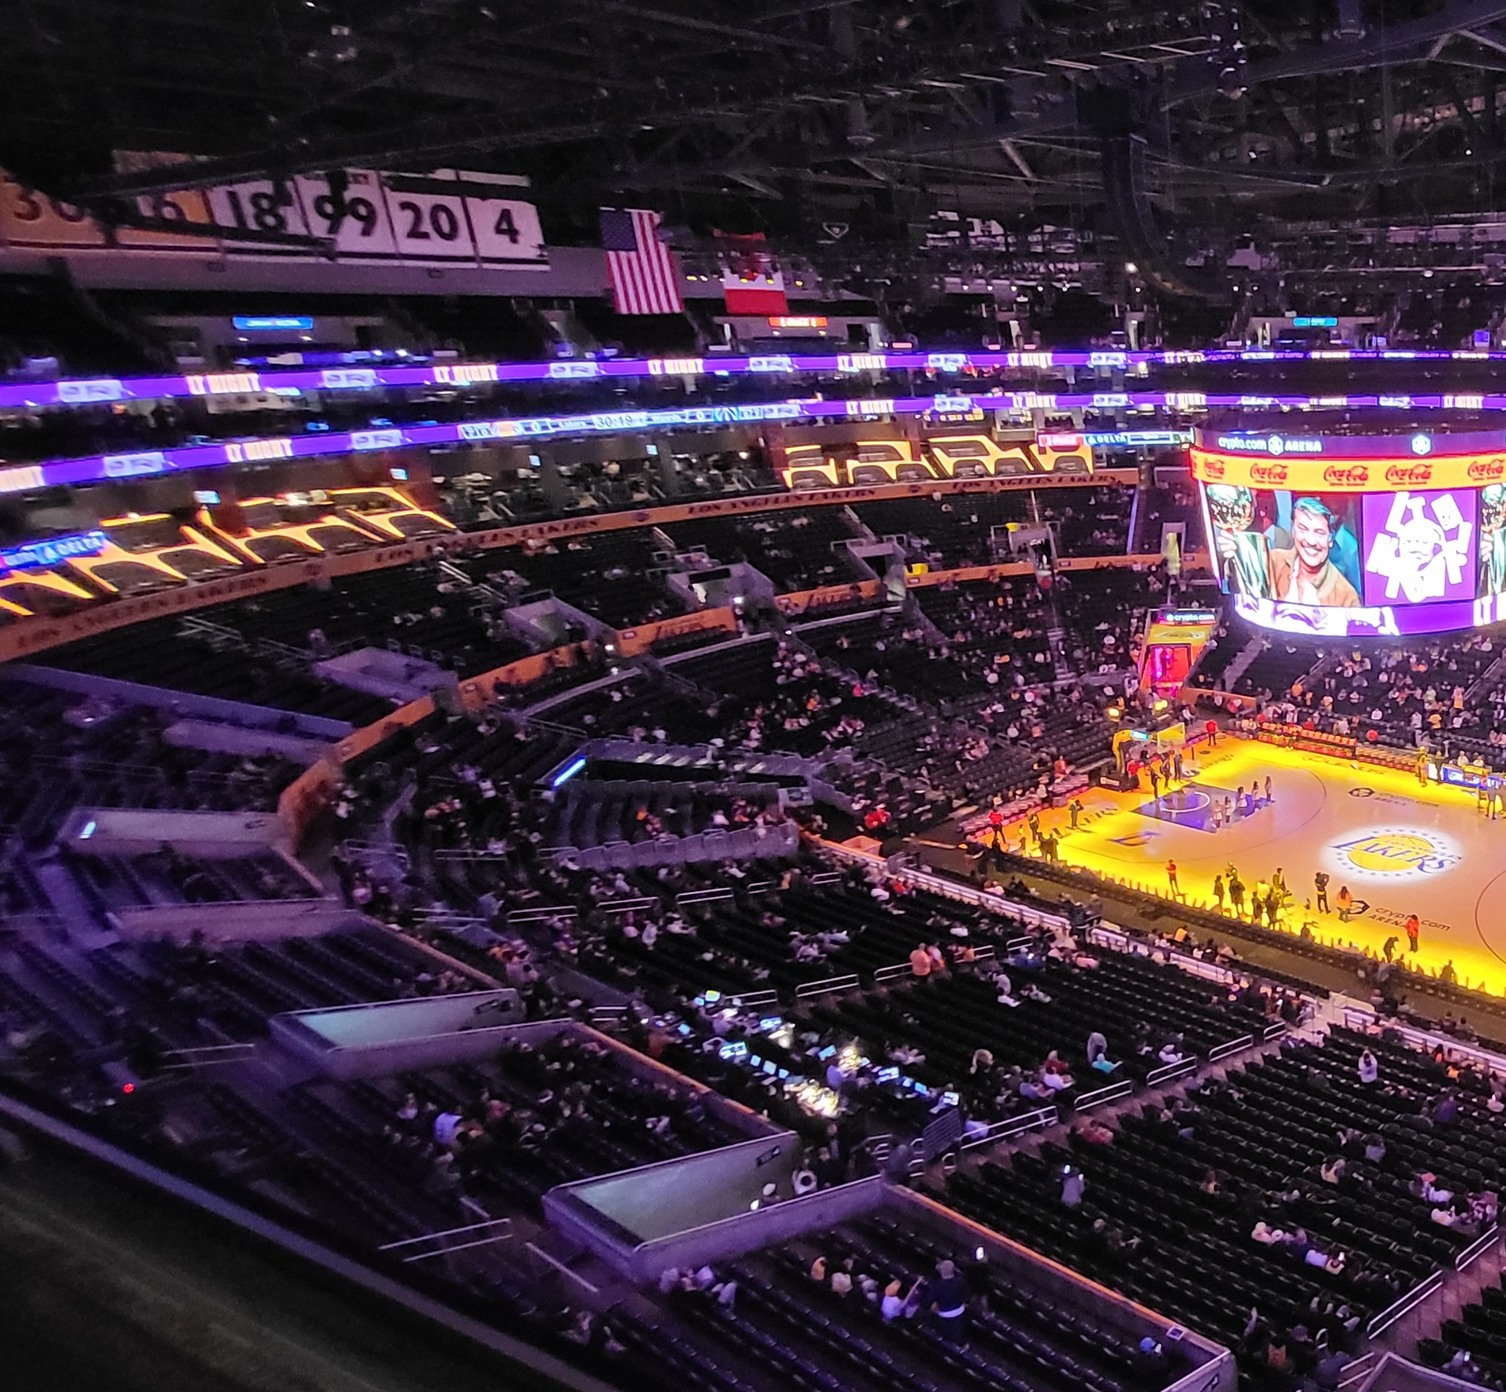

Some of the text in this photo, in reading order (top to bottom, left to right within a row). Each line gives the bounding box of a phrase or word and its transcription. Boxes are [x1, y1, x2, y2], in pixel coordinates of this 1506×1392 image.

[227, 189, 287, 232] 18
[314, 194, 377, 236] 99
[398, 200, 459, 242] 20
[493, 208, 519, 244] 4
[1218, 436, 1322, 452] crypto.com ARENA
[1324, 465, 1369, 482] Coca-Cola
[1385, 463, 1433, 482] Coca-Cola
[1174, 613, 1215, 622] crypto.com
[1327, 835, 1464, 874] LAKERS
